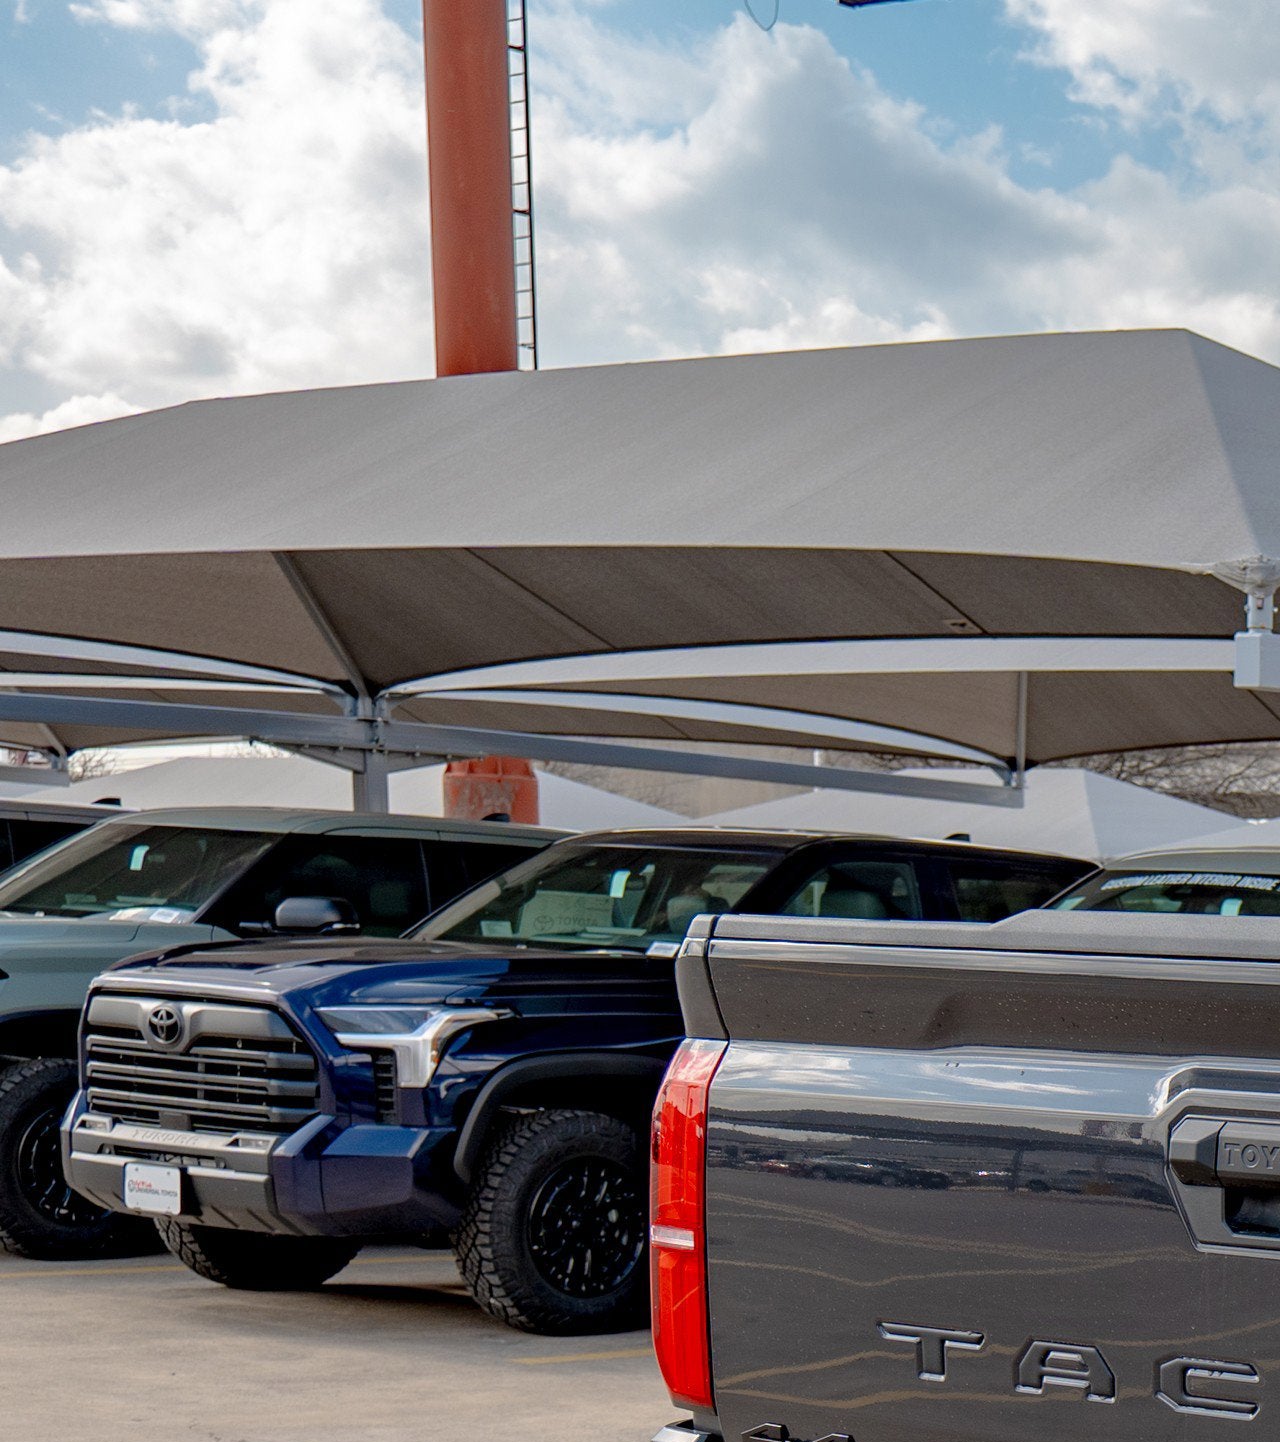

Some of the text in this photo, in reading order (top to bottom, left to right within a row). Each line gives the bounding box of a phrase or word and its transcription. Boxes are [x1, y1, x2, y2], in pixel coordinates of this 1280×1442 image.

[1142, 873, 1193, 886] LEATHER
[1186, 873, 1242, 887] INTERIOR
[1236, 875, 1280, 891] INSIDE
